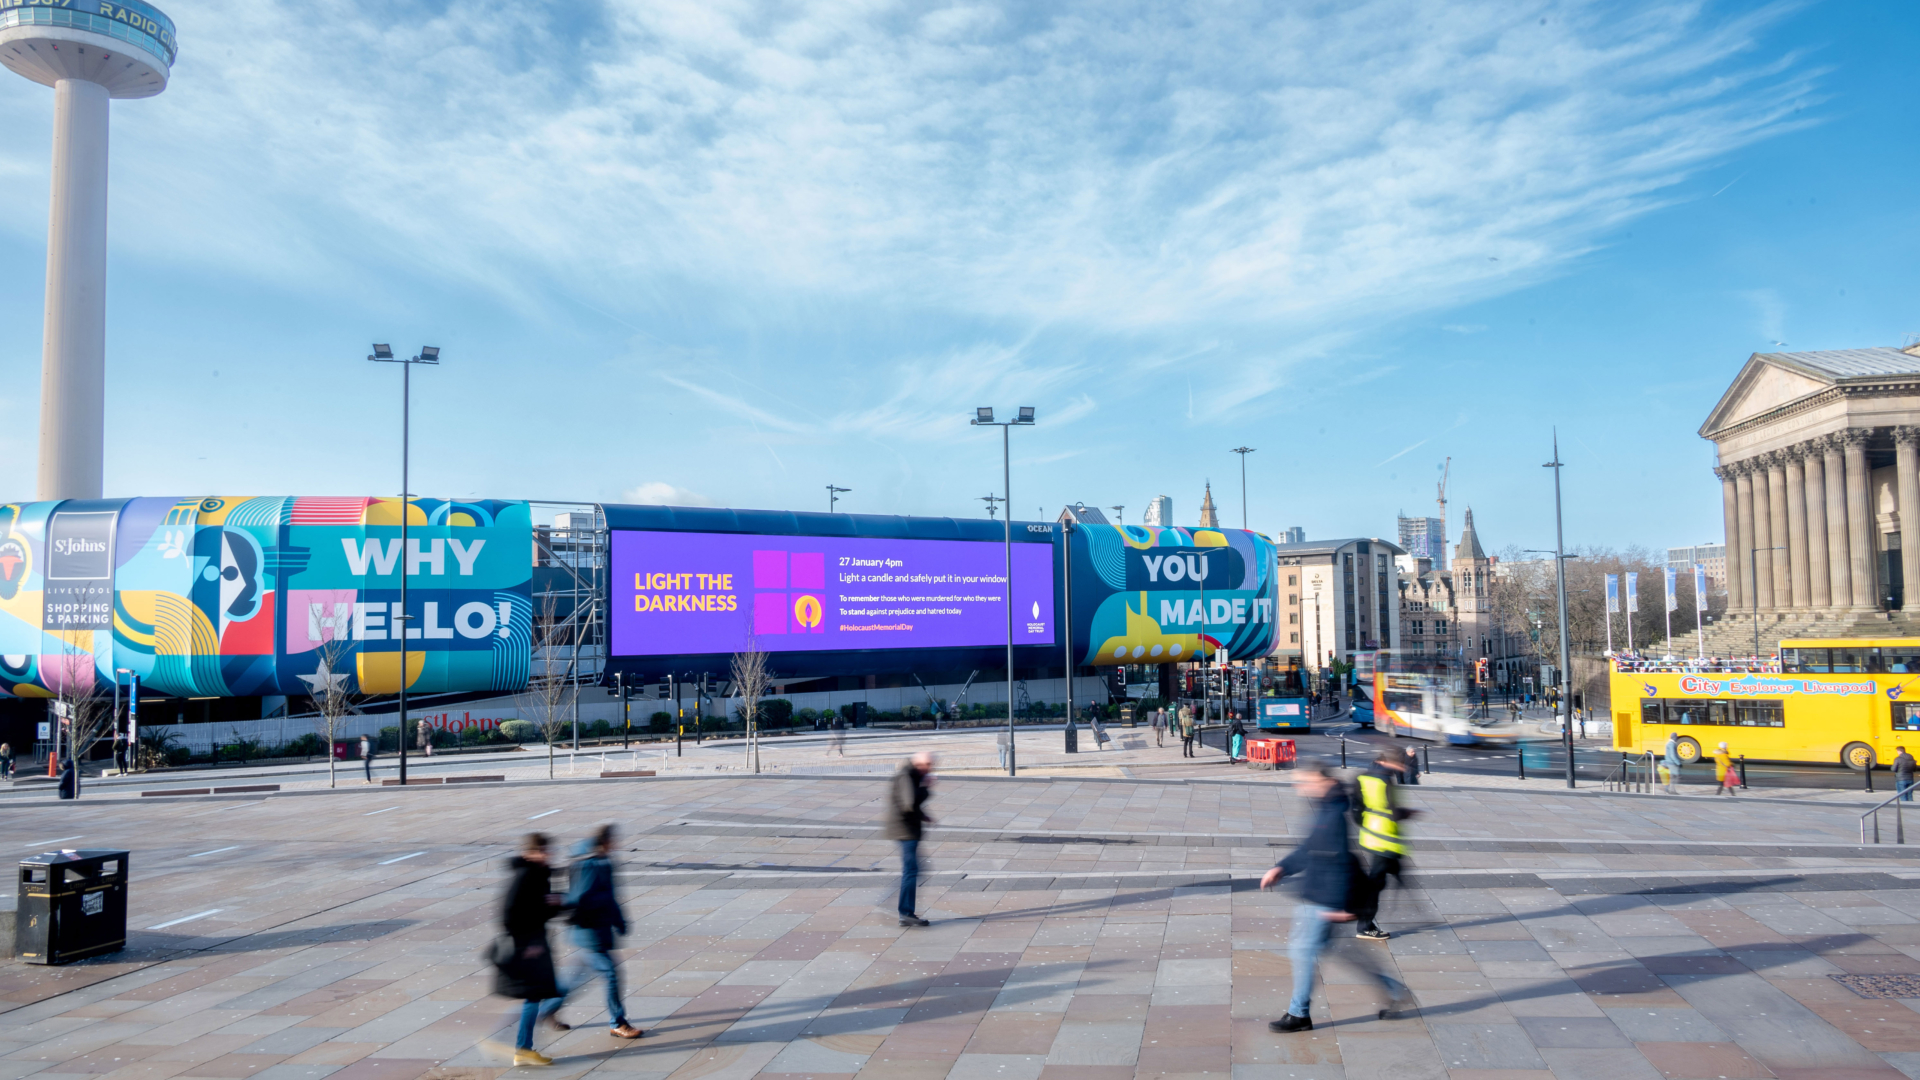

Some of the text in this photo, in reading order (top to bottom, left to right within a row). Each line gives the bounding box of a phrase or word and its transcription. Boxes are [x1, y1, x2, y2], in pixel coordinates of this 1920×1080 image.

[100, 2, 157, 35] RADIO
[1027, 525, 1053, 533] OCEAN
[341, 538, 487, 576] WHY
[839, 557, 903, 568] 27 January 4pm
[1142, 555, 1209, 582] YOU
[635, 573, 733, 590] LIGHT THE
[839, 573, 860, 584] Light
[867, 573, 893, 582] candle
[894, 573, 909, 583] and
[910, 573, 933, 584] safely
[933, 574, 947, 585] put
[947, 574, 953, 583] it
[954, 574, 961, 583] in
[962, 576, 979, 585] your
[979, 574, 1008, 584] window
[47, 587, 111, 595] LIVERPOOL
[635, 595, 738, 612] DARKNESS
[839, 594, 848, 602] To
[848, 594, 880, 602] remember
[880, 594, 897, 602] those
[897, 594, 911, 602] who
[926, 594, 954, 602] murdered
[954, 594, 963, 602] for
[963, 594, 975, 602] who
[975, 594, 988, 603] they
[47, 603, 110, 613] SHOPPING
[839, 607, 962, 617] To stand against prejudice and hatred today
[1160, 598, 1246, 626] MADE
[46, 614, 110, 624] & PARKING
[308, 601, 512, 641] HELLO!
[839, 623, 914, 632] #HolocaustMemorialDay
[1681, 677, 1875, 695] City Explorer Liverpool
